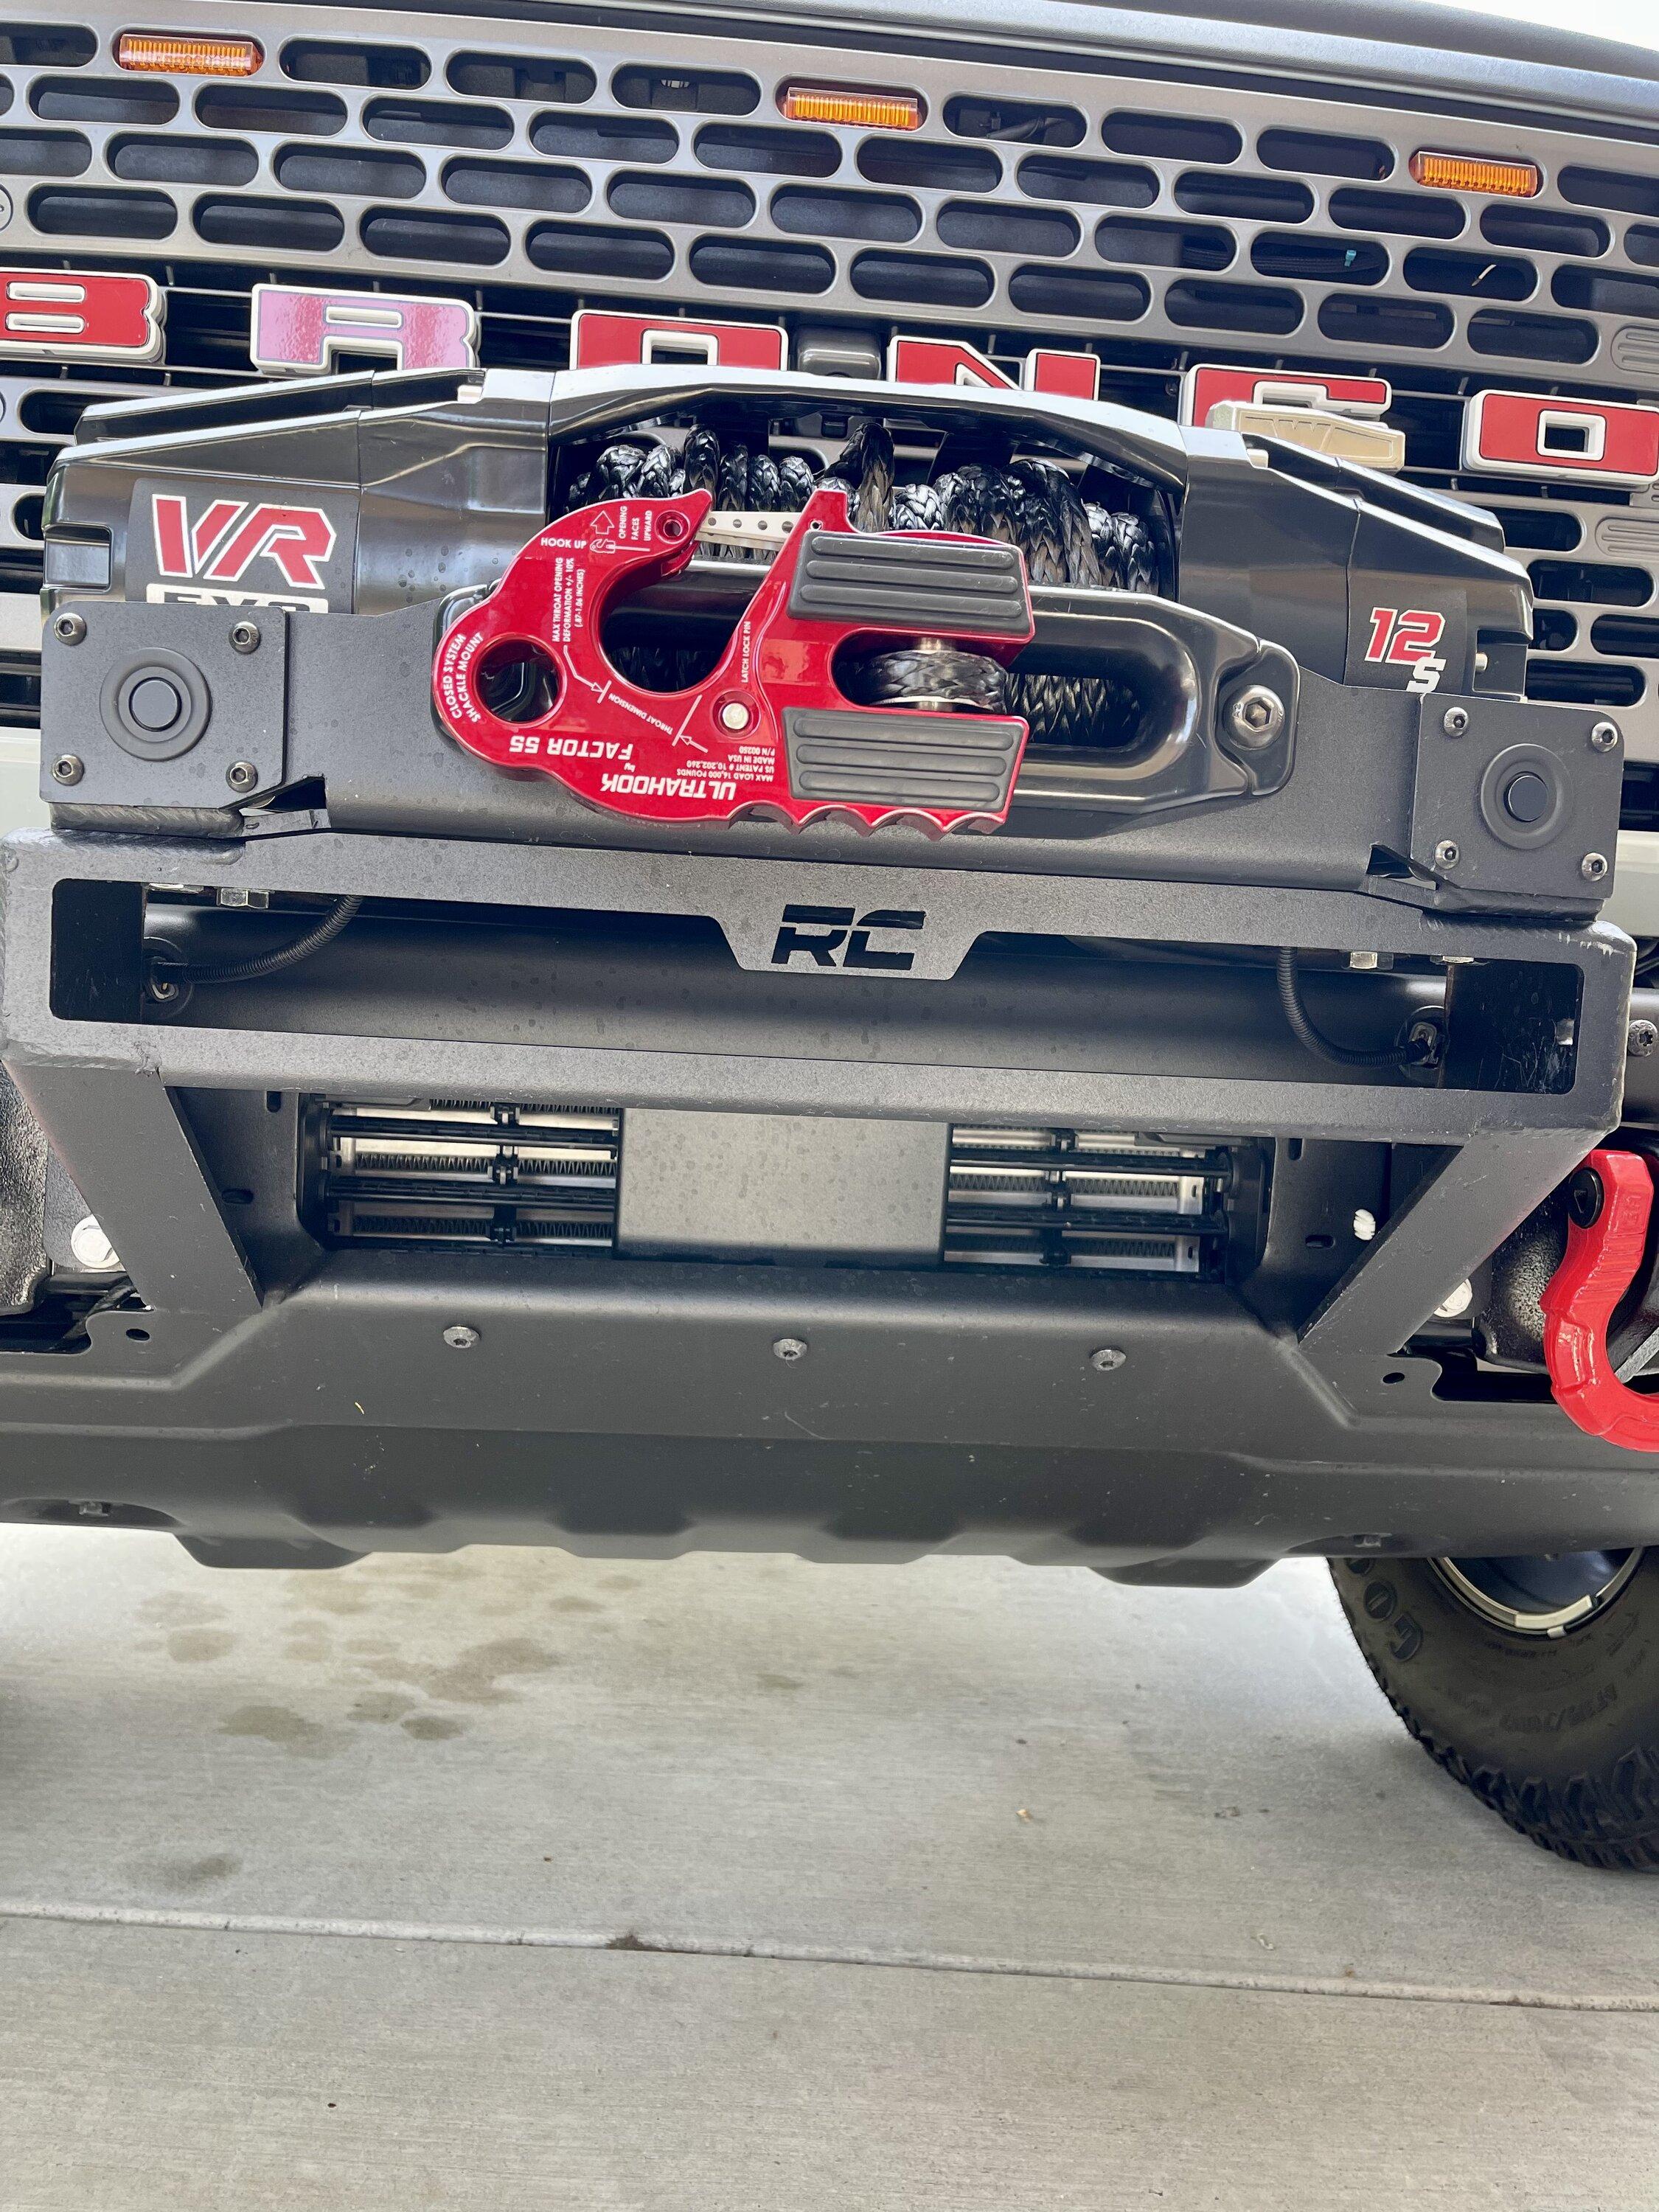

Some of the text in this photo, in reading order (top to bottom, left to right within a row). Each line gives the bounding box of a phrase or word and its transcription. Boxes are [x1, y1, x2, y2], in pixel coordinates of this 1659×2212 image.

[618, 505, 627, 539] OPENING
[631, 517, 640, 540] FACES
[643, 509, 653, 541] UPWARD
[152, 493, 336, 590] VR
[540, 537, 587, 549] HOOK UP
[566, 557, 574, 573] 10%
[576, 568, 585, 597] INCHES)
[552, 557, 563, 642] MAX THROAT OPENING
[563, 588, 572, 642] DEFORMATION
[741, 621, 751, 684] LATCH LOCK PIN
[442, 633, 467, 719] CLOSED SYSTEM
[456, 632, 484, 723] SHACKLE MOUNT
[608, 693, 673, 735] THROAT DIMENSION
[509, 735, 634, 760] FACTOR 55
[727, 754, 742, 763] USA
[753, 757, 775, 765] MADE
[762, 748, 775, 757] P/N
[624, 762, 636, 773] by
[676, 768, 773, 782] MAX LOAD 16,000 POUNDS
[735, 764, 763, 773] PATENT
[765, 765, 774, 774] US
[599, 773, 737, 801] ULTRAHOOK
[771, 904, 927, 971] RC
